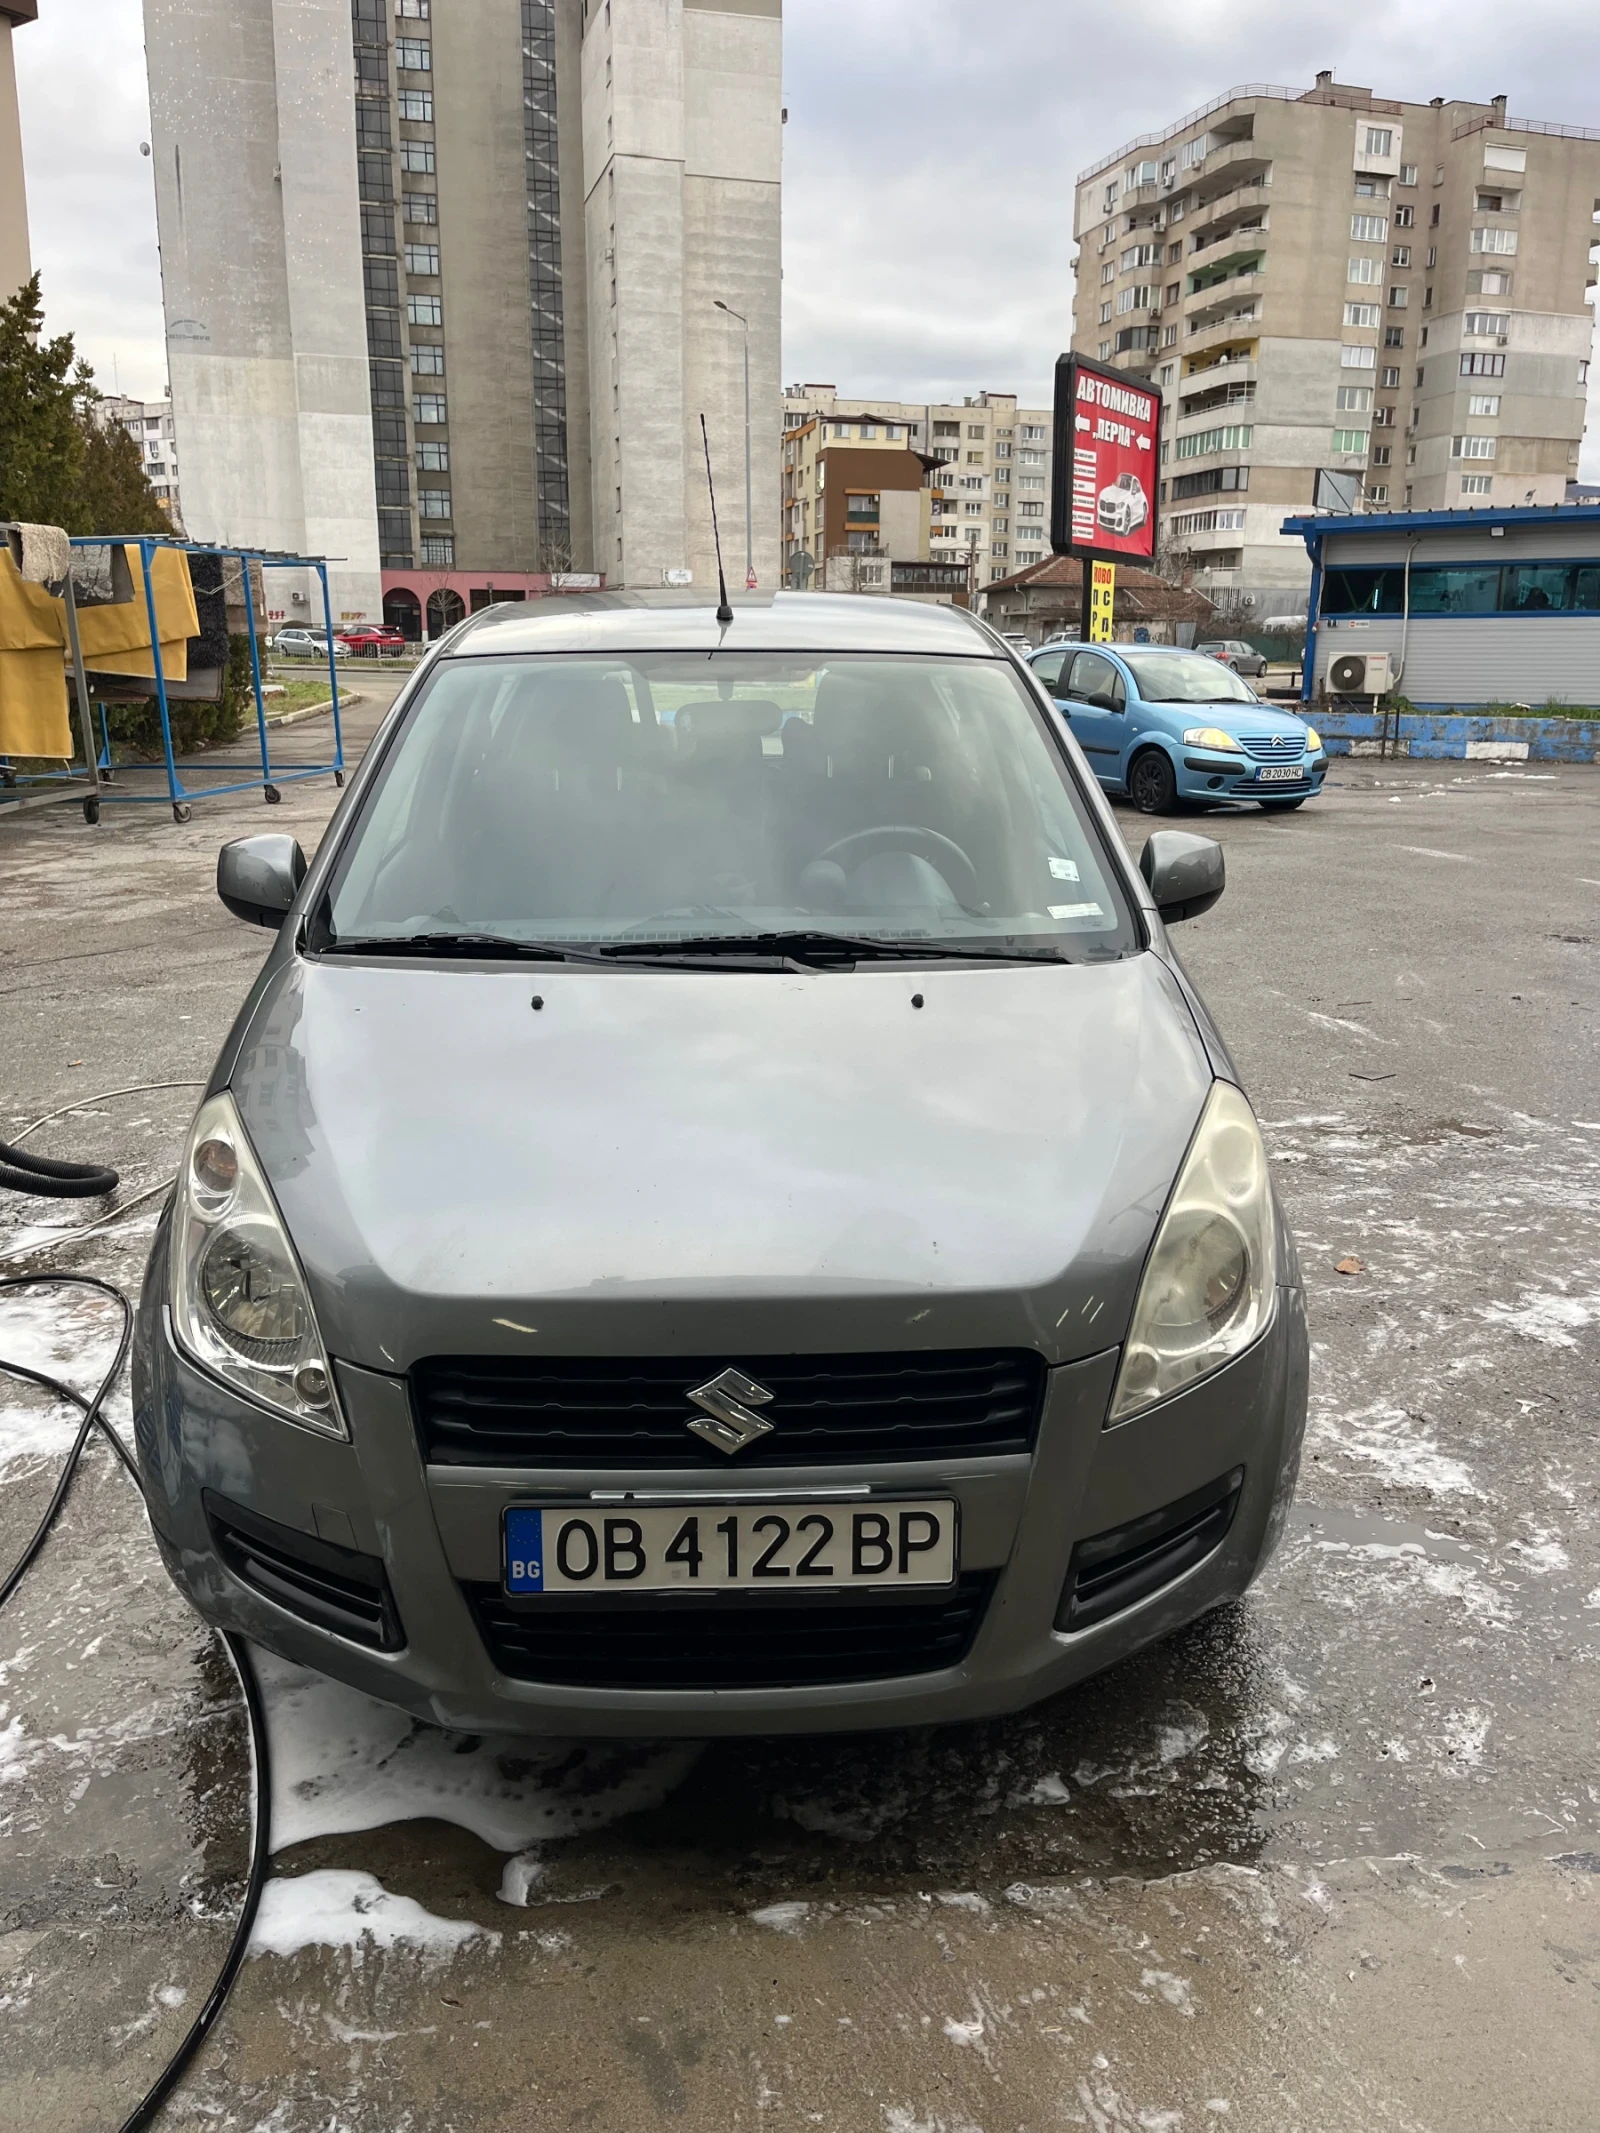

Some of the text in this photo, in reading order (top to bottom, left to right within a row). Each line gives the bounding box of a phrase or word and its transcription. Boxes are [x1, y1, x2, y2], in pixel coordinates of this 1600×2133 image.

[1076, 376, 1151, 422] АВТОМИВКА
[1093, 567, 1112, 584] НОВО
[1272, 769, 1291, 778] 2030
[664, 1515, 834, 1578] 4122
[512, 1560, 540, 1579] BG
